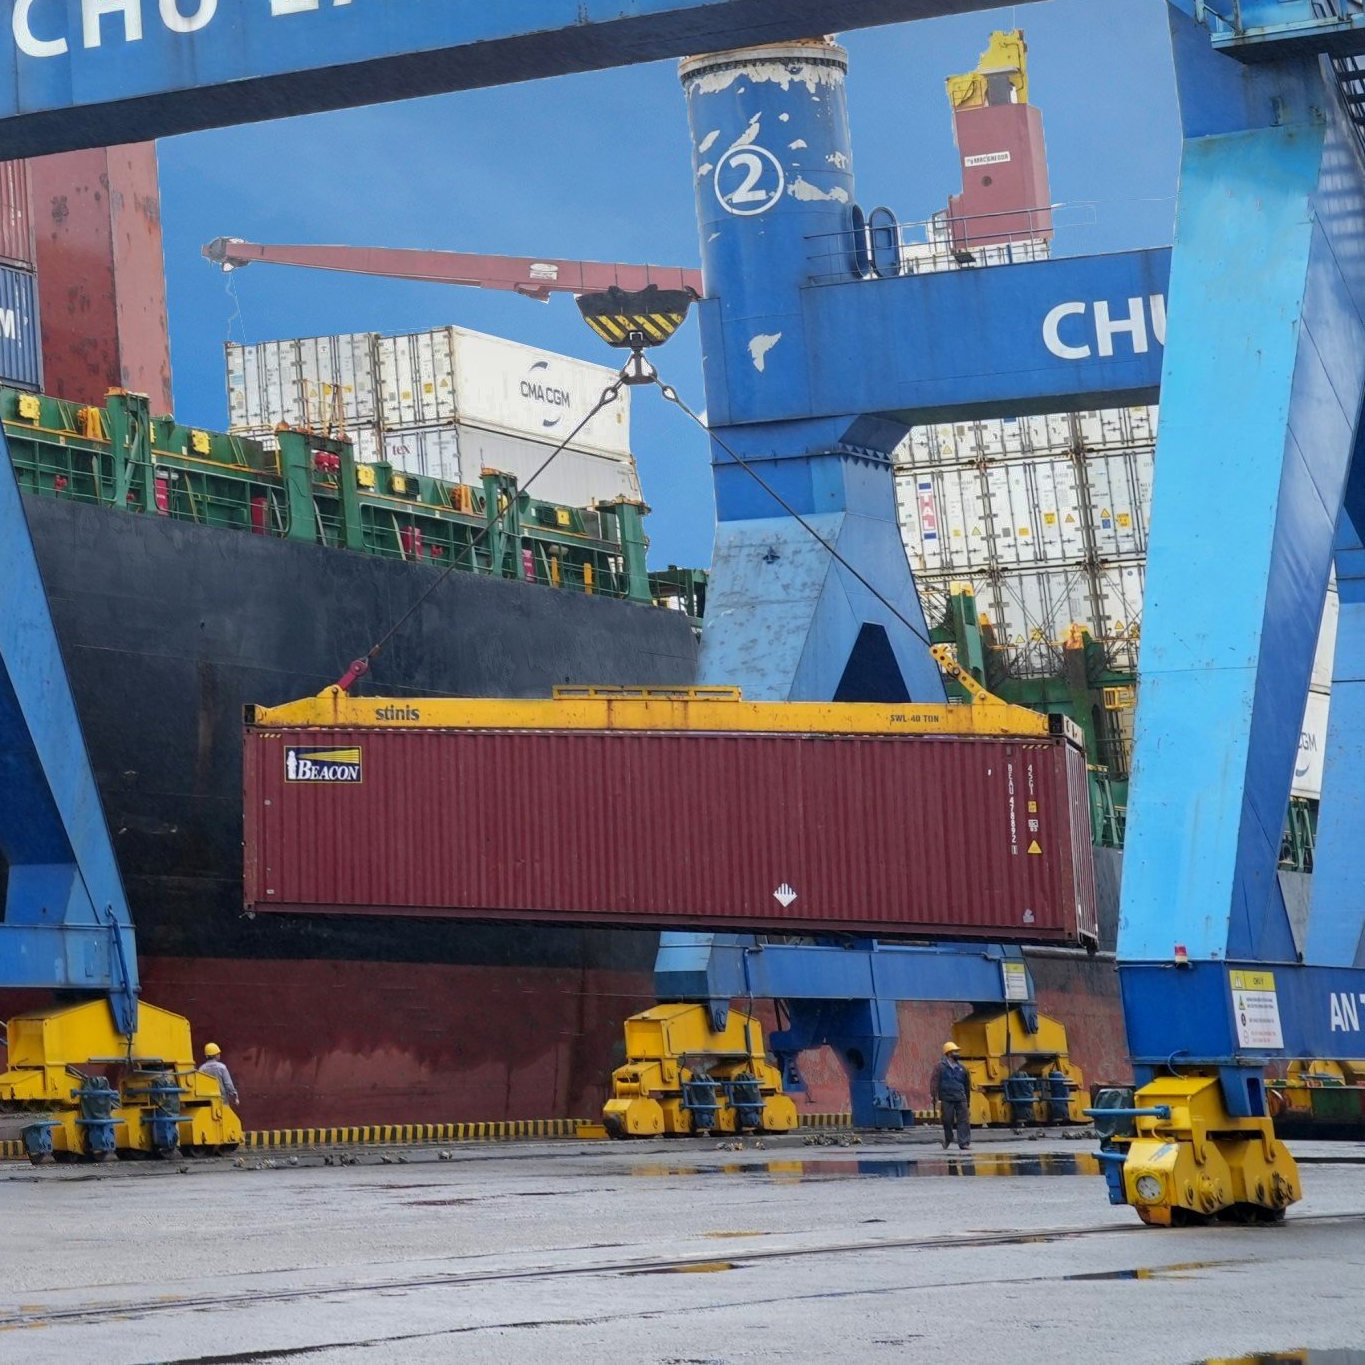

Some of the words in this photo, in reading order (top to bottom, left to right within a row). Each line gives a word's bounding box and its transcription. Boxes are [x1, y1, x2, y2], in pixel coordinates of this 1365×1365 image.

[729, 153, 767, 204] 2
[520, 381, 544, 401] CMA
[546, 388, 571, 408] CGM
[392, 444, 411, 457] tex
[375, 705, 420, 721] stinis
[890, 714, 907, 723] SWL
[922, 714, 939, 723] TON
[1331, 992, 1361, 1032] AN
